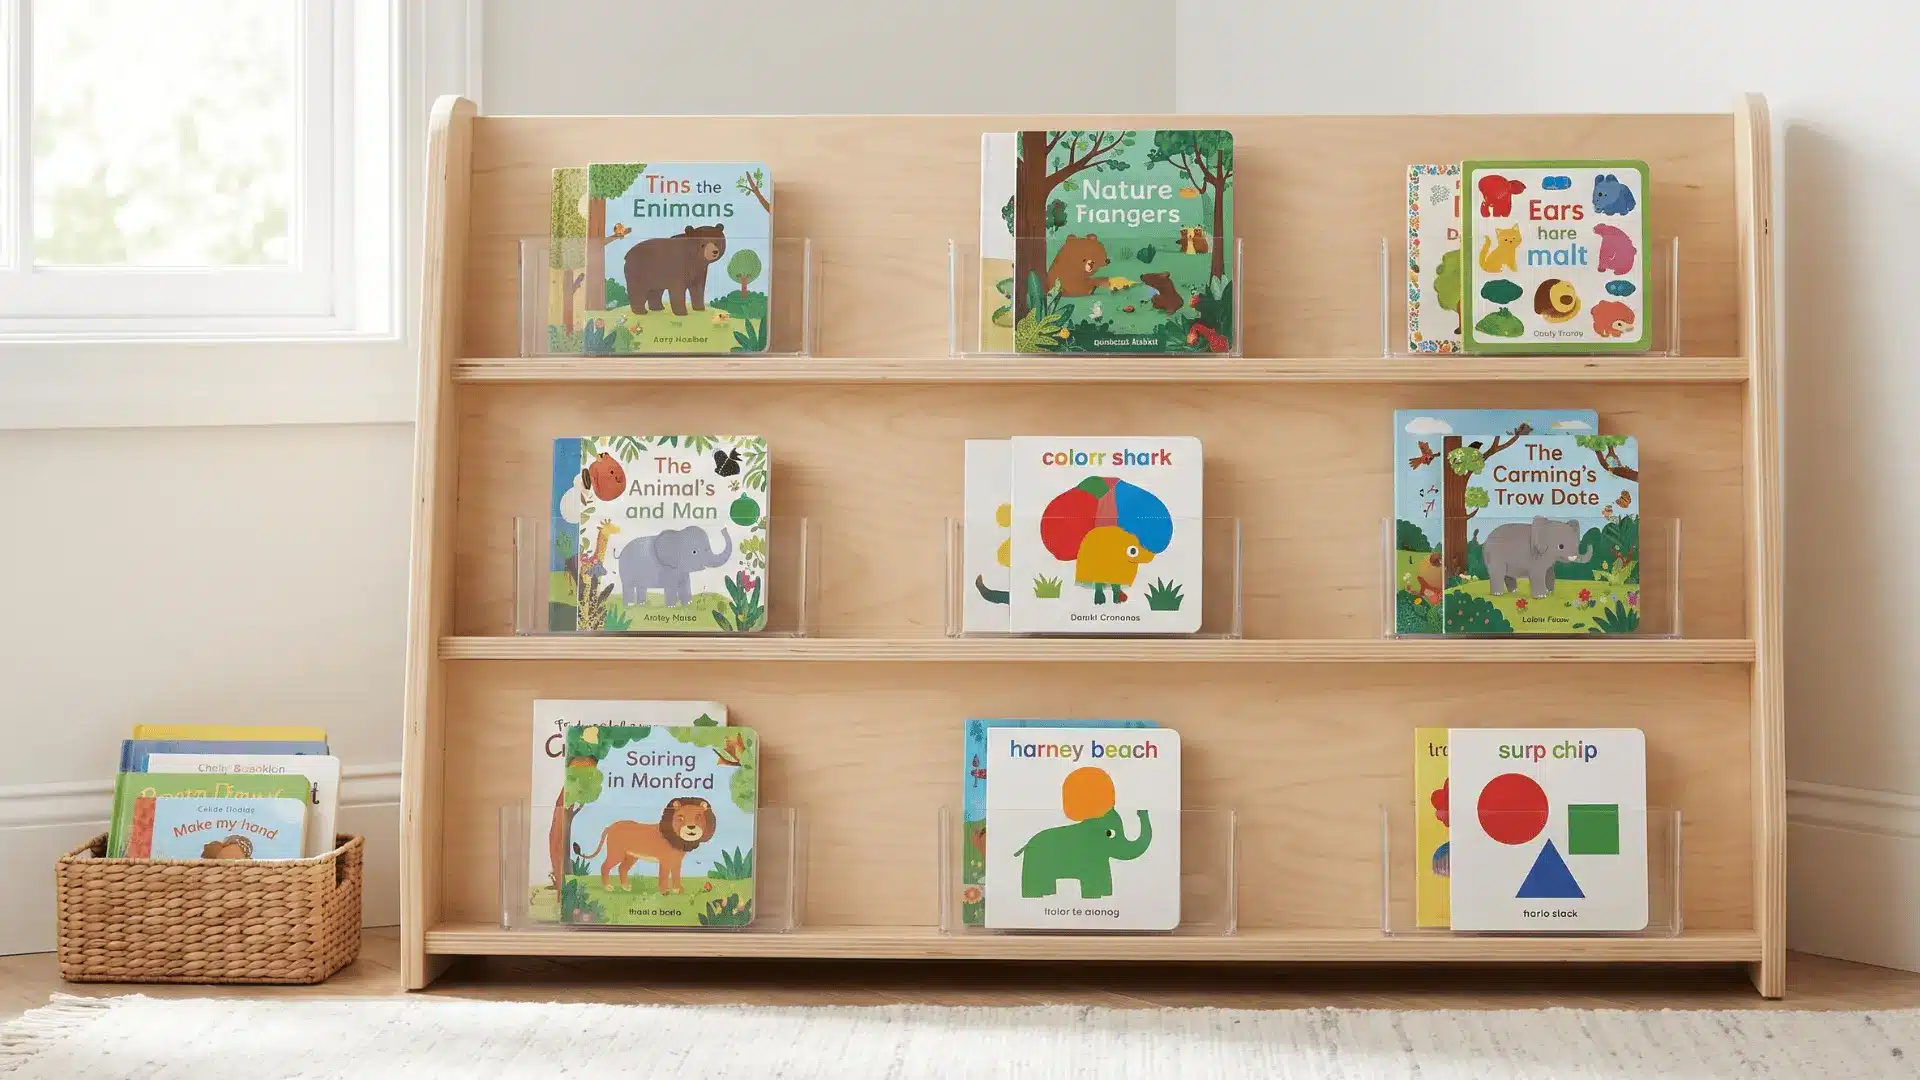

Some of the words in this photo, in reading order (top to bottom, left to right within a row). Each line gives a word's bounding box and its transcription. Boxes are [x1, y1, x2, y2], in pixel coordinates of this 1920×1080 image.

[645, 175, 691, 195] Tins
[696, 180, 722, 194] the
[1082, 178, 1172, 200] Nature
[633, 198, 734, 218] Enimans
[1529, 199, 1584, 221] Ears
[1537, 226, 1577, 240] hare
[1527, 243, 1588, 266] malt
[1042, 449, 1106, 466] colorr
[1112, 449, 1173, 466] shark
[1524, 444, 1563, 461] The
[654, 456, 691, 474] The
[1493, 465, 1597, 487] Carming's
[628, 479, 716, 497] Animal's
[1495, 489, 1544, 505] Trow
[1551, 489, 1600, 506] Dote
[625, 502, 664, 519] and
[673, 502, 718, 519] Man
[1010, 740, 1084, 762] harney
[1091, 740, 1158, 759] beach
[1498, 743, 1547, 763] surp
[1552, 740, 1598, 763] chip
[626, 751, 696, 772] Soiring
[608, 772, 624, 788] in
[631, 772, 714, 789] Monford
[172, 819, 213, 839] Make
[216, 818, 238, 832] my
[240, 818, 279, 841] hand
[1552, 909, 1578, 917] slack
